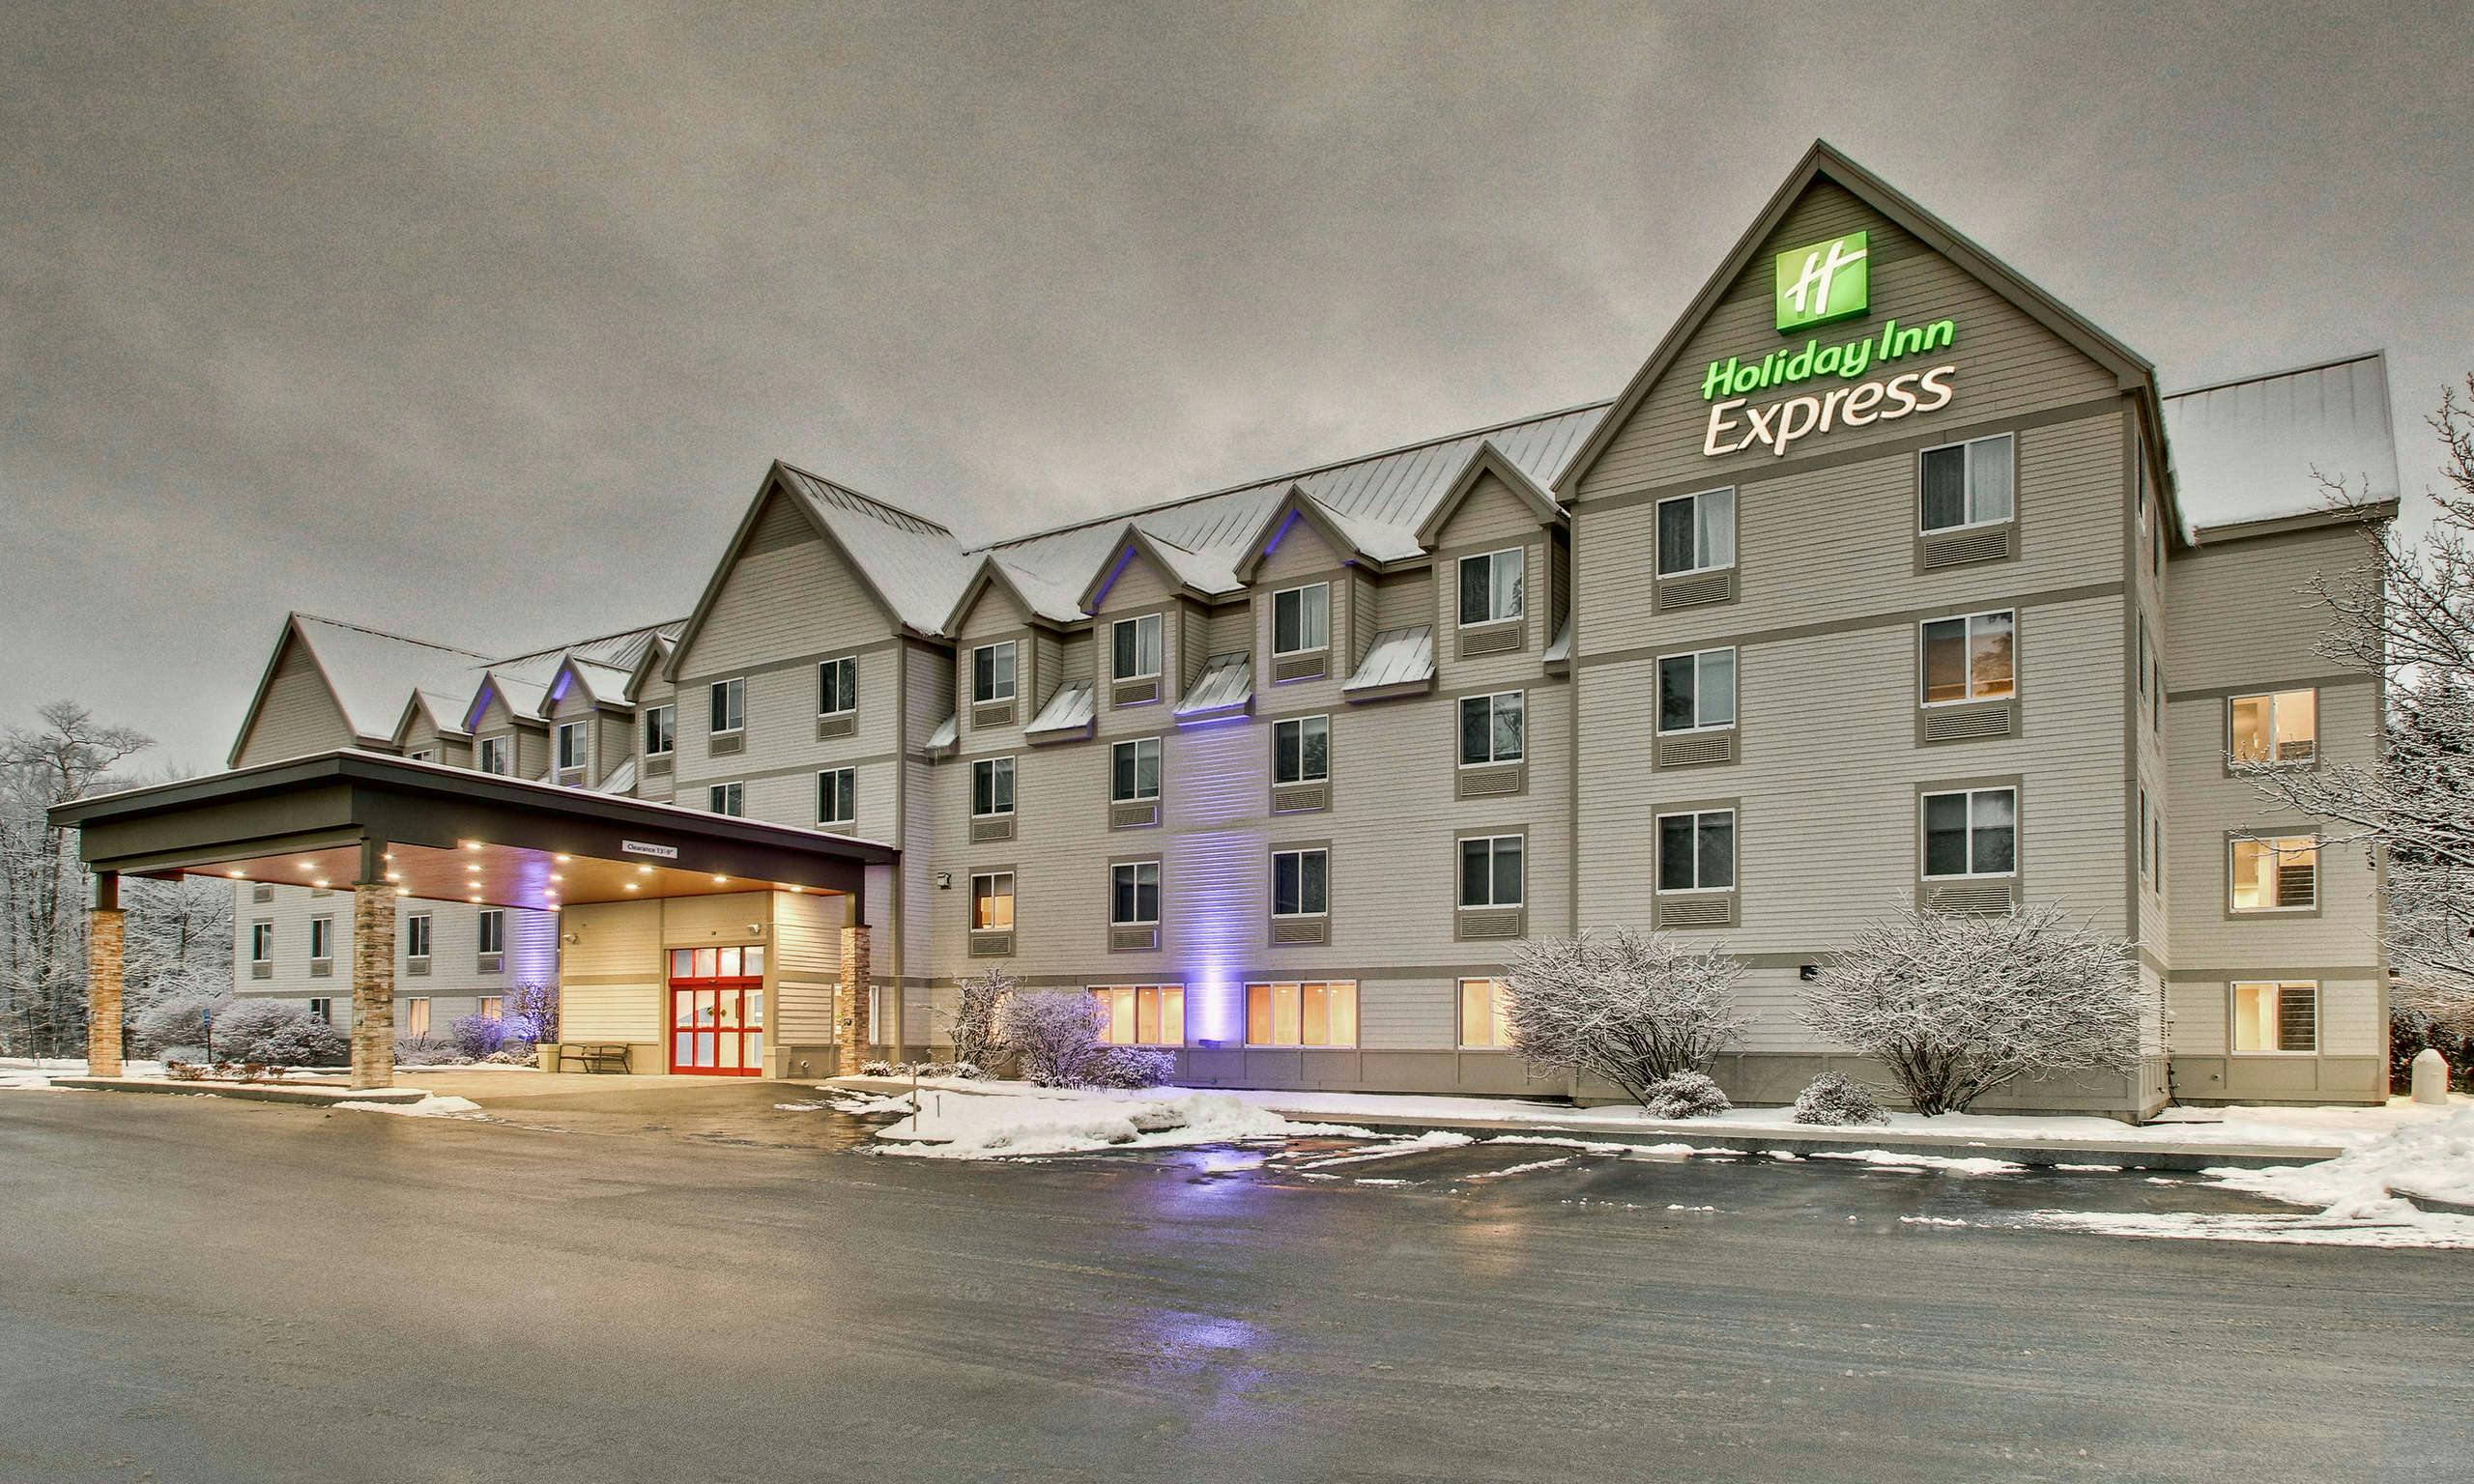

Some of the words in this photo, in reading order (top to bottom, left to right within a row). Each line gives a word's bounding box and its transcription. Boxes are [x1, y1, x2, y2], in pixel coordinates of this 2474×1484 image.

[1701, 338, 1873, 401] Holiday
[1879, 319, 1956, 361] Inn
[1702, 365, 1957, 458] Express
[627, 843, 656, 853] Clearance
